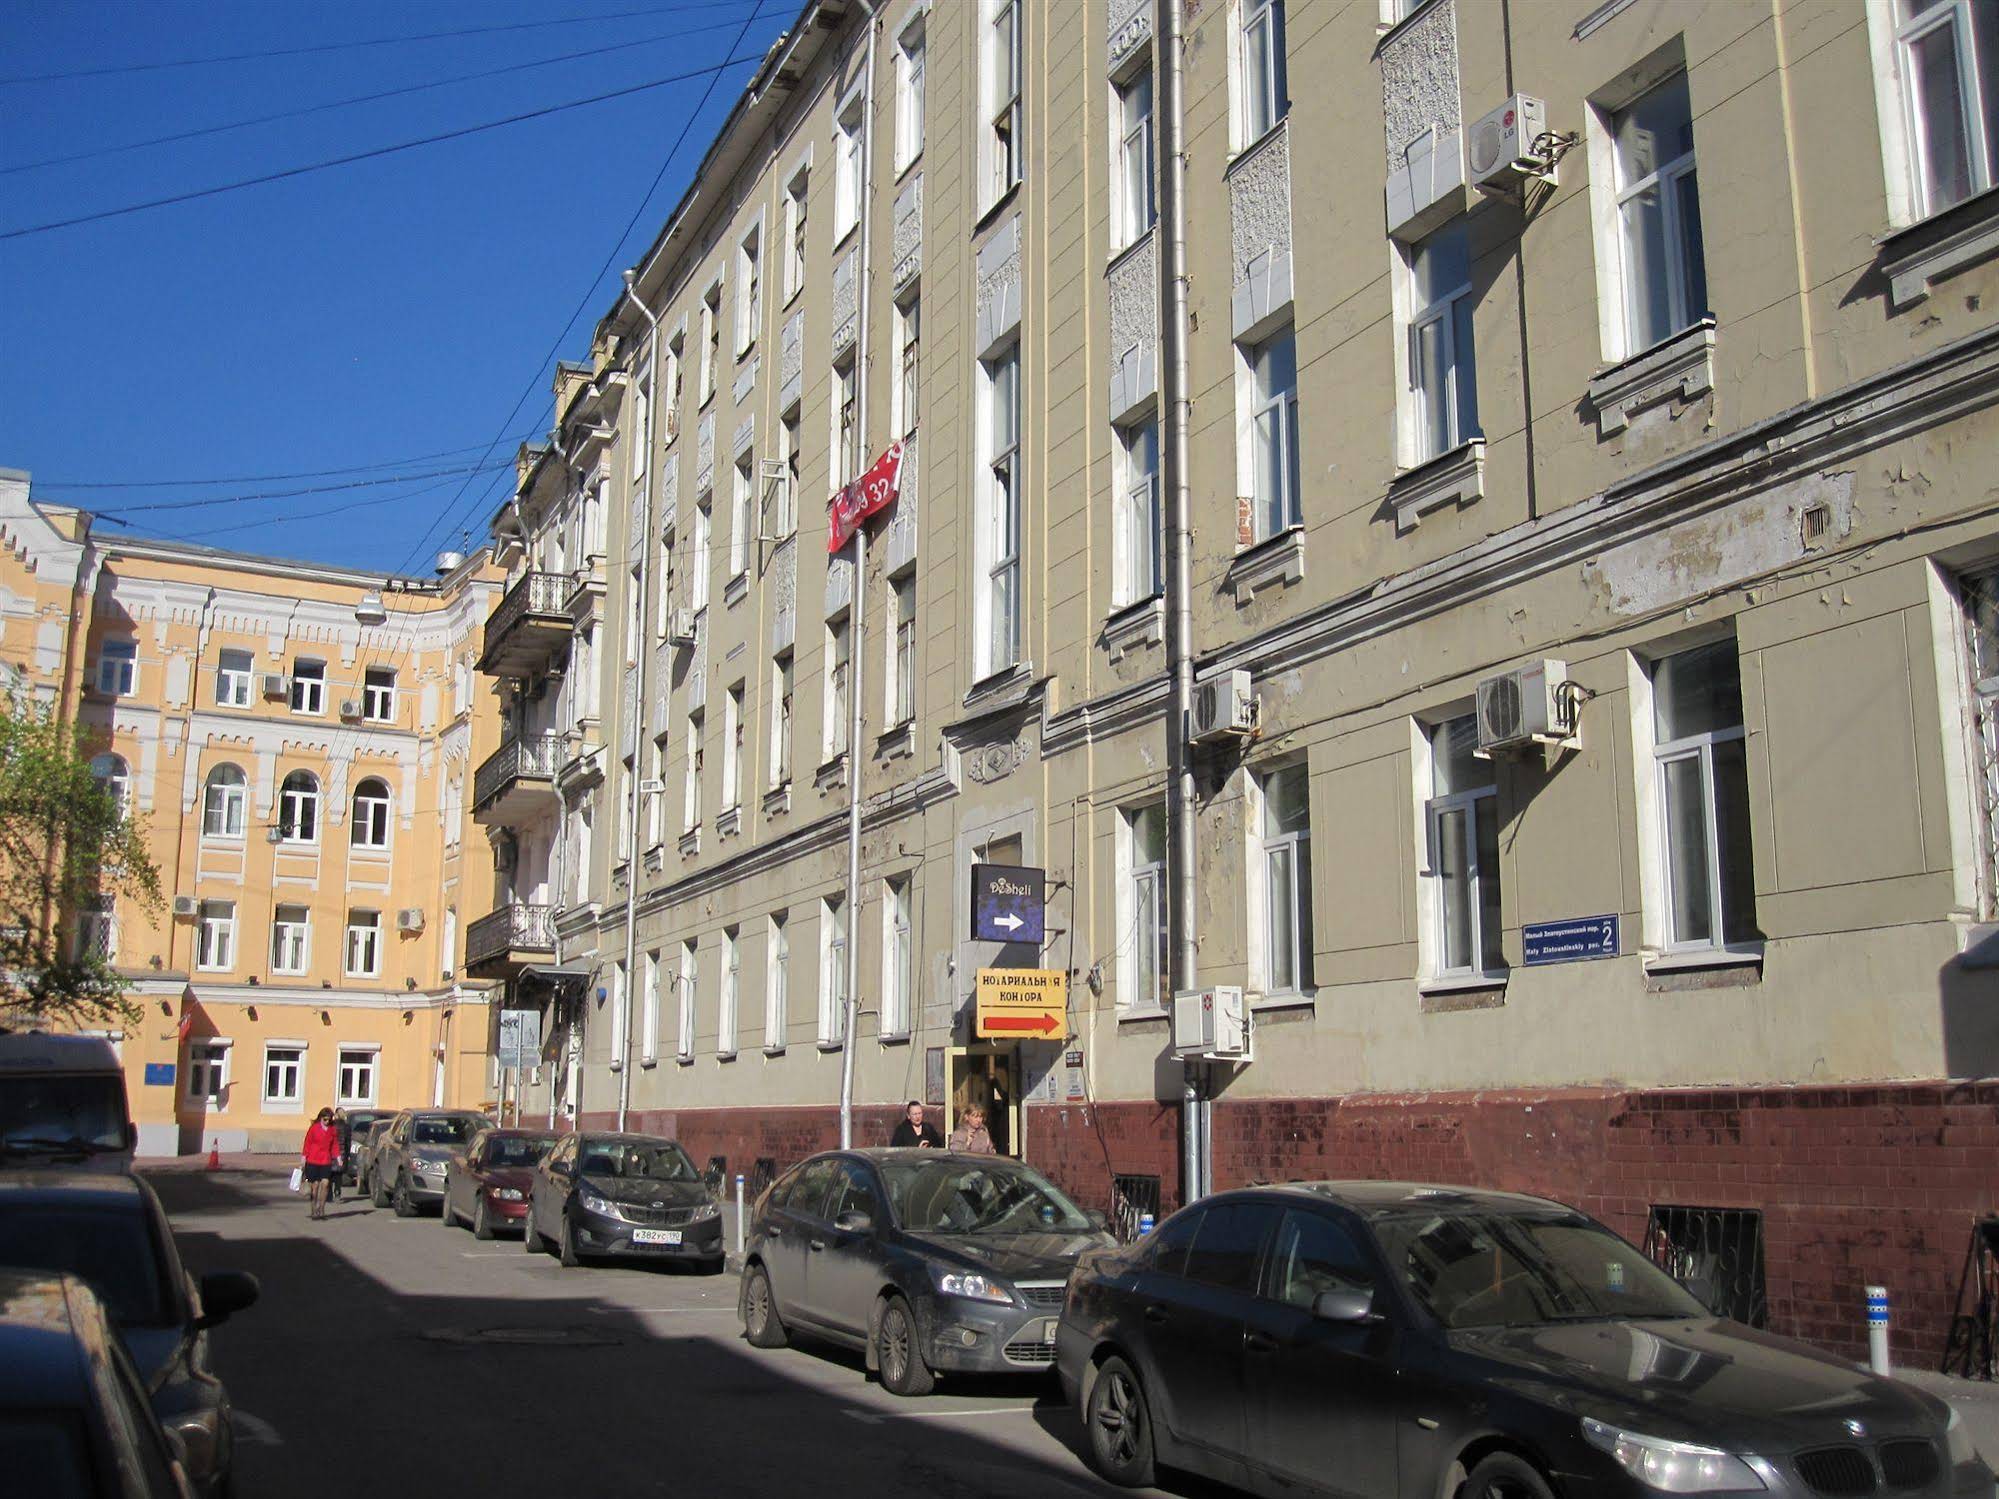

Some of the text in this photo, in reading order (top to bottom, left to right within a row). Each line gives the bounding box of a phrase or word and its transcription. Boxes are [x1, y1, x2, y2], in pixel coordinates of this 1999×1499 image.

[1504, 128, 1514, 139] LG
[990, 881, 1031, 896] DeSheli
[1602, 926, 1612, 946] 2
[982, 975, 1060, 987] НОАРИАЛЬНЯ
